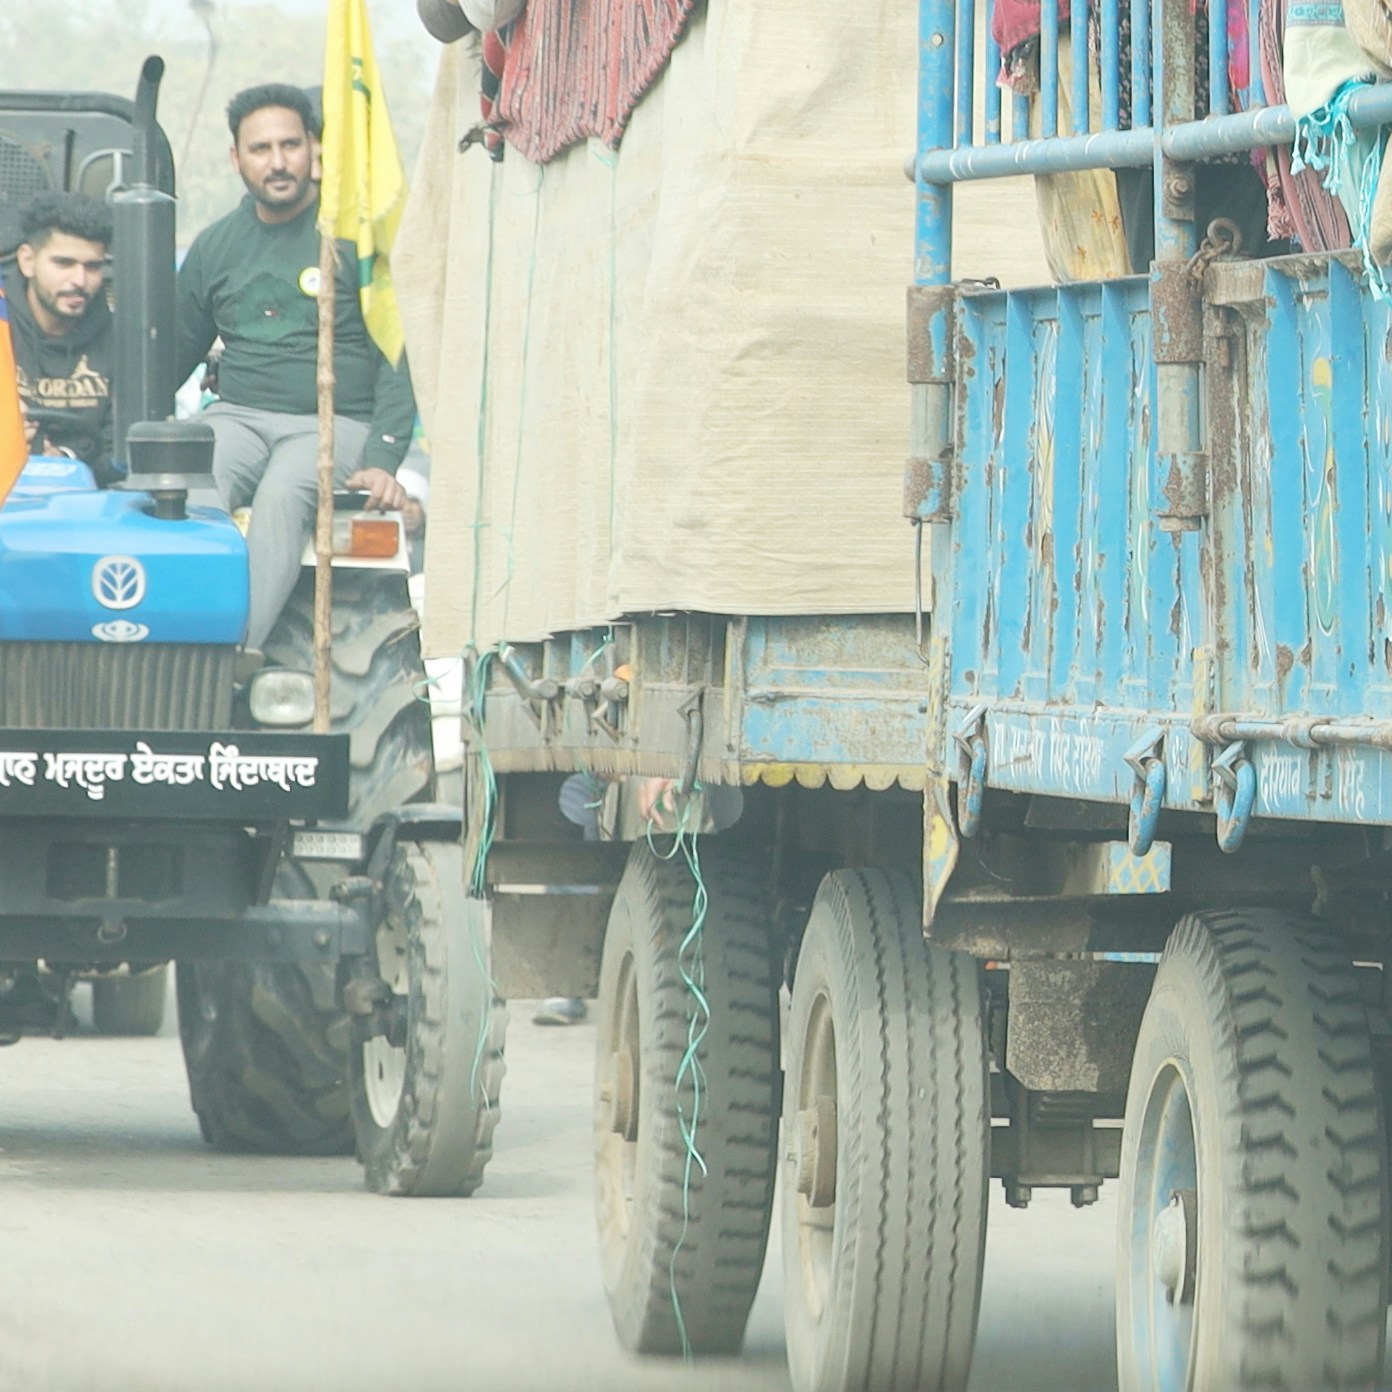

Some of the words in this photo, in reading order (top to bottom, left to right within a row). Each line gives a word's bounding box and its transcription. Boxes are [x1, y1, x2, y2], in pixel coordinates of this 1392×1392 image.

[34, 377, 109, 398] ORDAN
[43, 752, 128, 800] ਮਜਦੂਰ
[130, 741, 205, 785] ਏਕਤਾ
